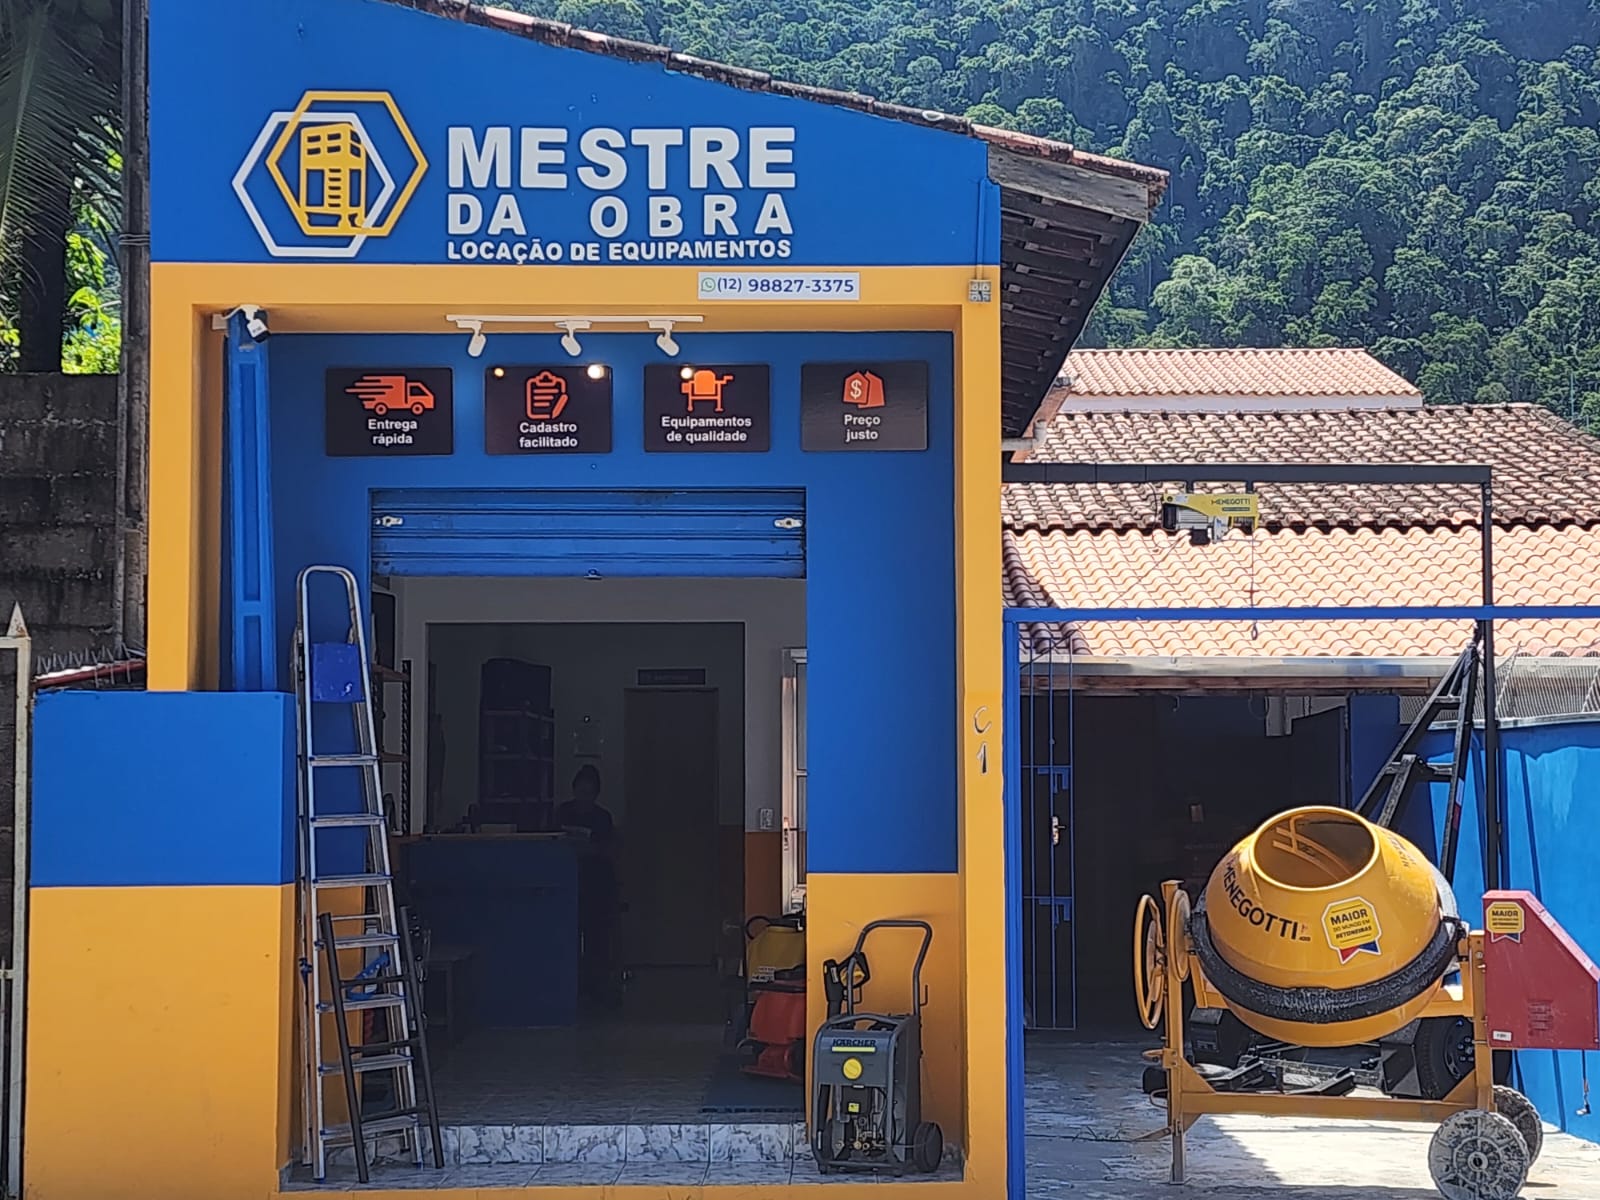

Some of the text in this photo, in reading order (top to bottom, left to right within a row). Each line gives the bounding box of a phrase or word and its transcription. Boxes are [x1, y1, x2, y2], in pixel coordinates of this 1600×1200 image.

[448, 127, 795, 190] MESTRE
[448, 193, 793, 238] DA OBRA
[448, 239, 791, 264] LOCAÇÃO DE EQUIPAMENTOS
[717, 277, 854, 293] (12) 98827-3375
[368, 419, 418, 434] Entrega
[519, 421, 577, 433] Cadastro
[661, 415, 752, 429] Equipamentos
[844, 414, 881, 428] Preço
[373, 432, 413, 445] rápida
[519, 434, 577, 448] facilitado
[666, 429, 747, 443] de qualidade
[846, 428, 878, 442] justo
[1223, 859, 1298, 940] MENEGOTTI
[1330, 908, 1368, 925] MAIOR
